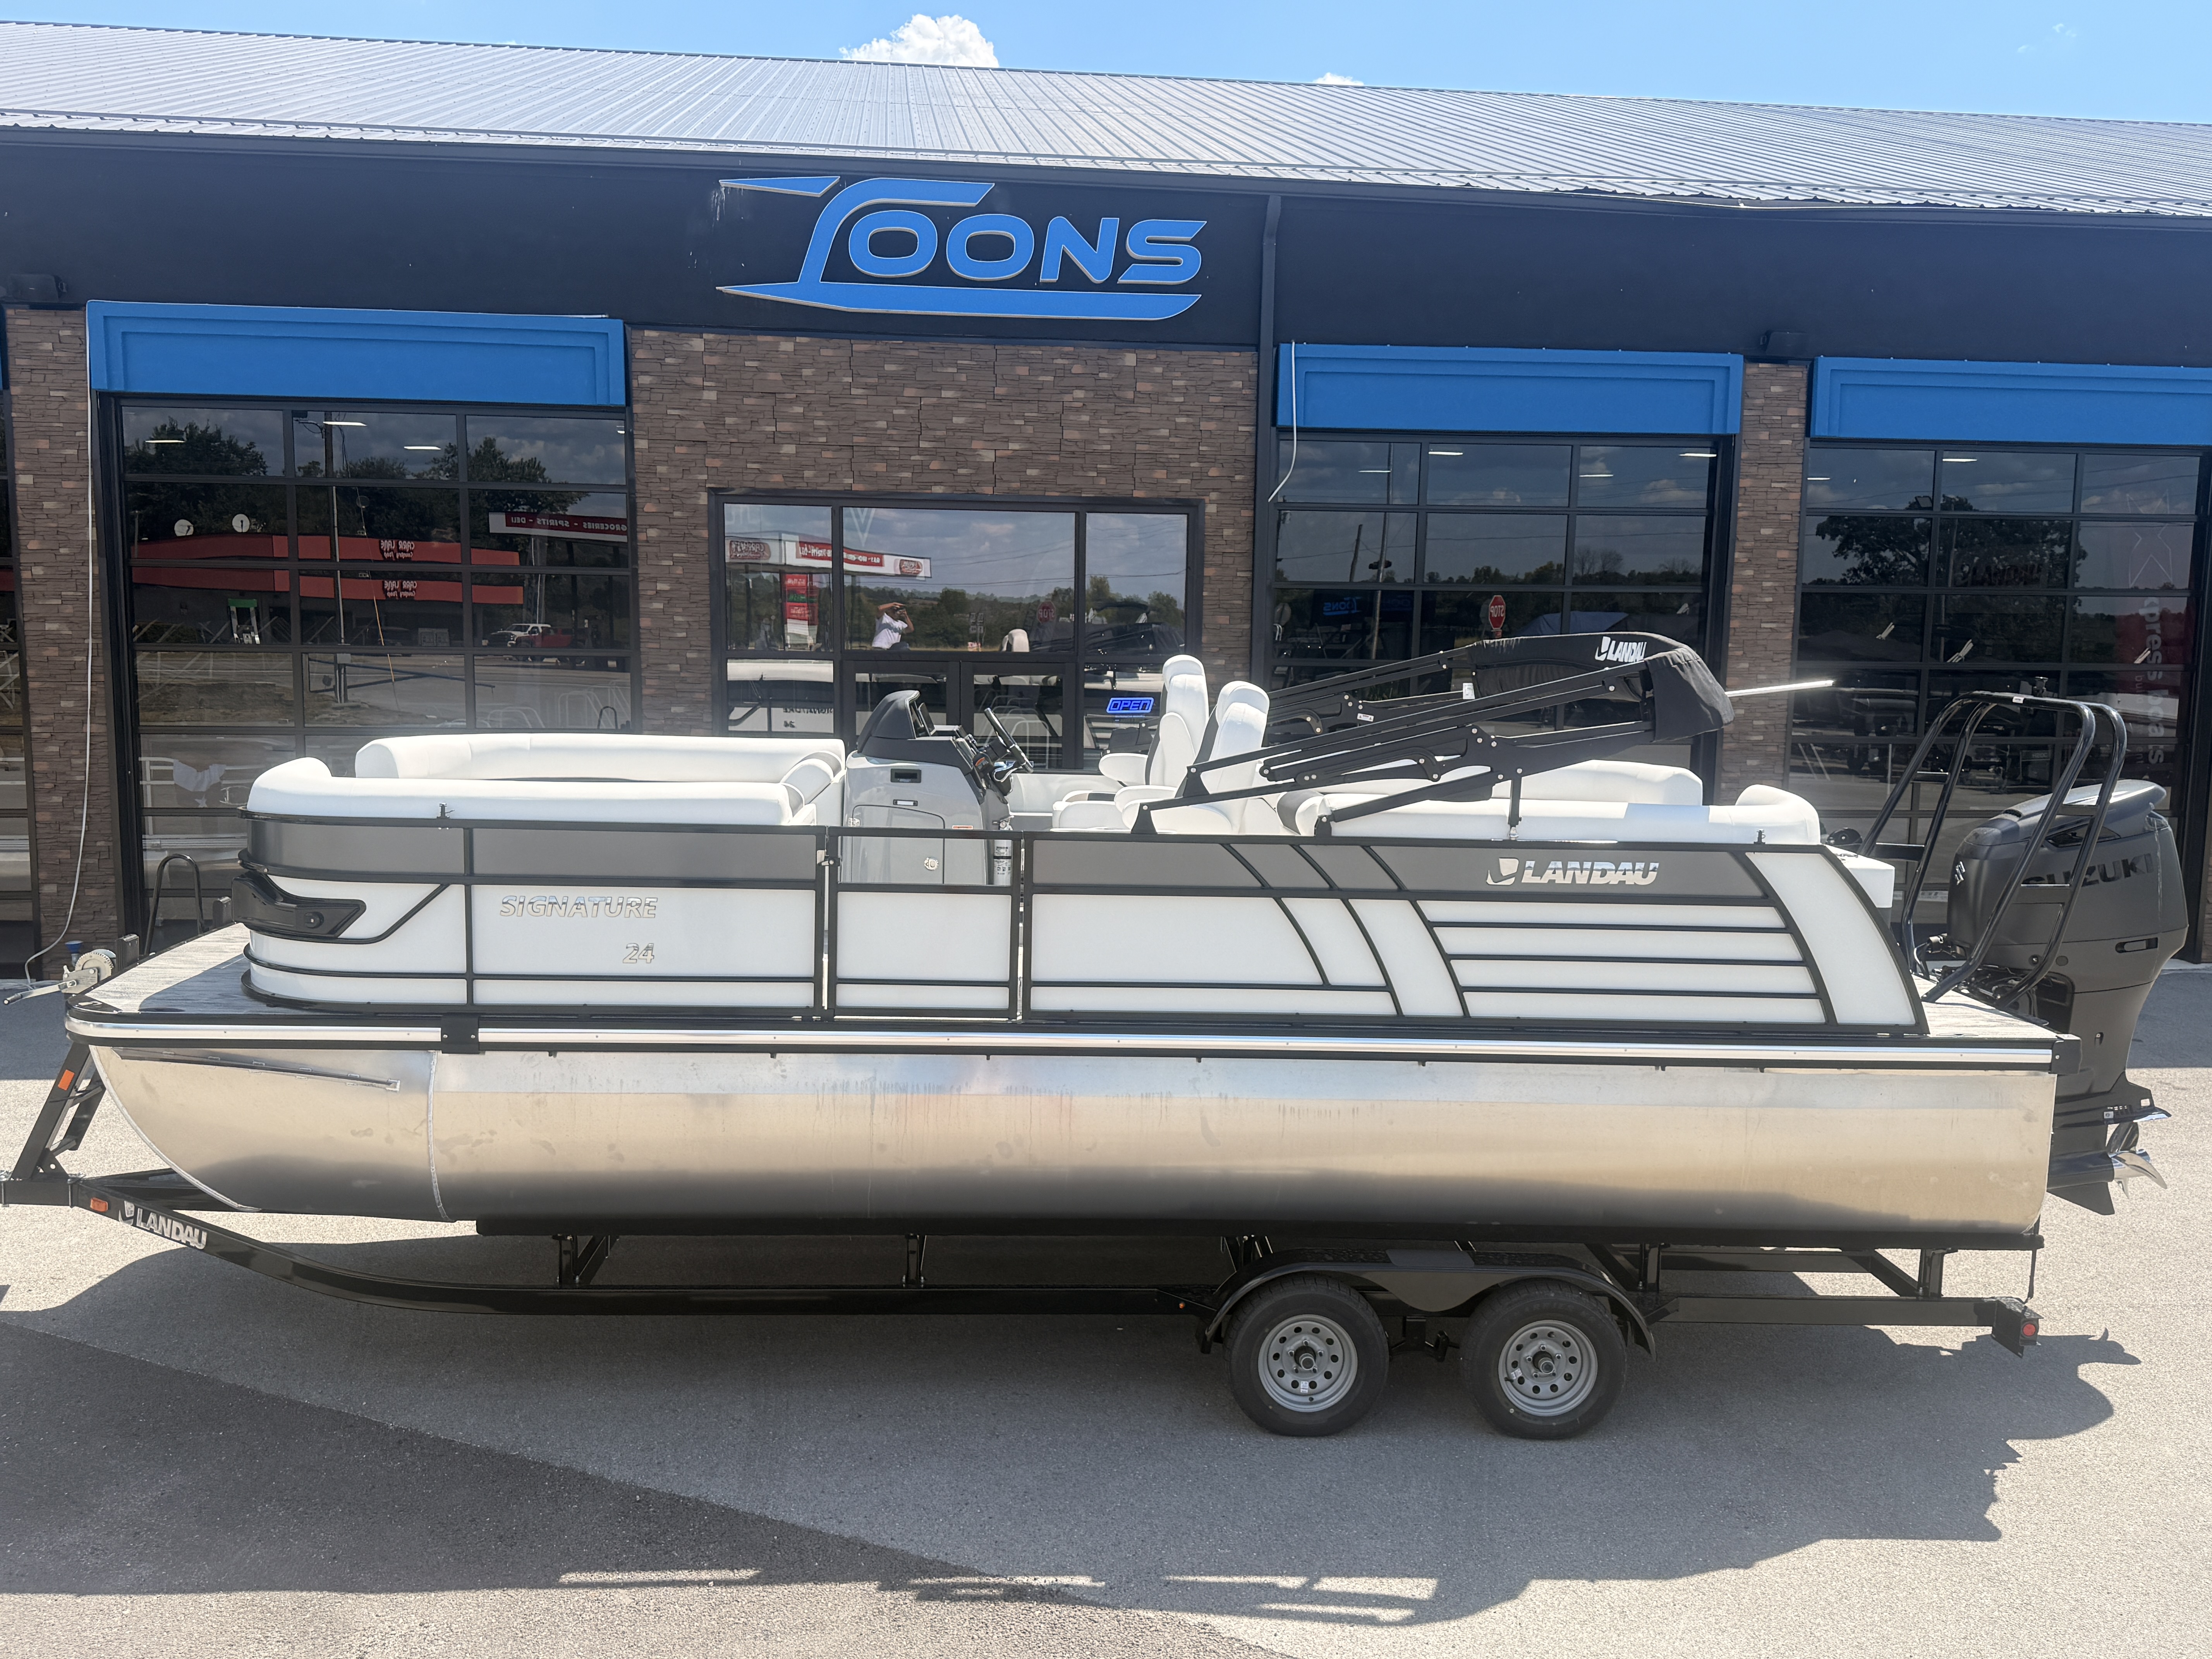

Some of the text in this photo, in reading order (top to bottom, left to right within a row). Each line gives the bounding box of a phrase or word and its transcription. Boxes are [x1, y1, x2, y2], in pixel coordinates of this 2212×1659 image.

[1110, 700, 1151, 710] OPEN
[1521, 861, 1659, 885] LANDAU
[500, 895, 658, 918] SIGNATURE
[623, 943, 654, 963] 24
[136, 1207, 208, 1250] LANDAU
